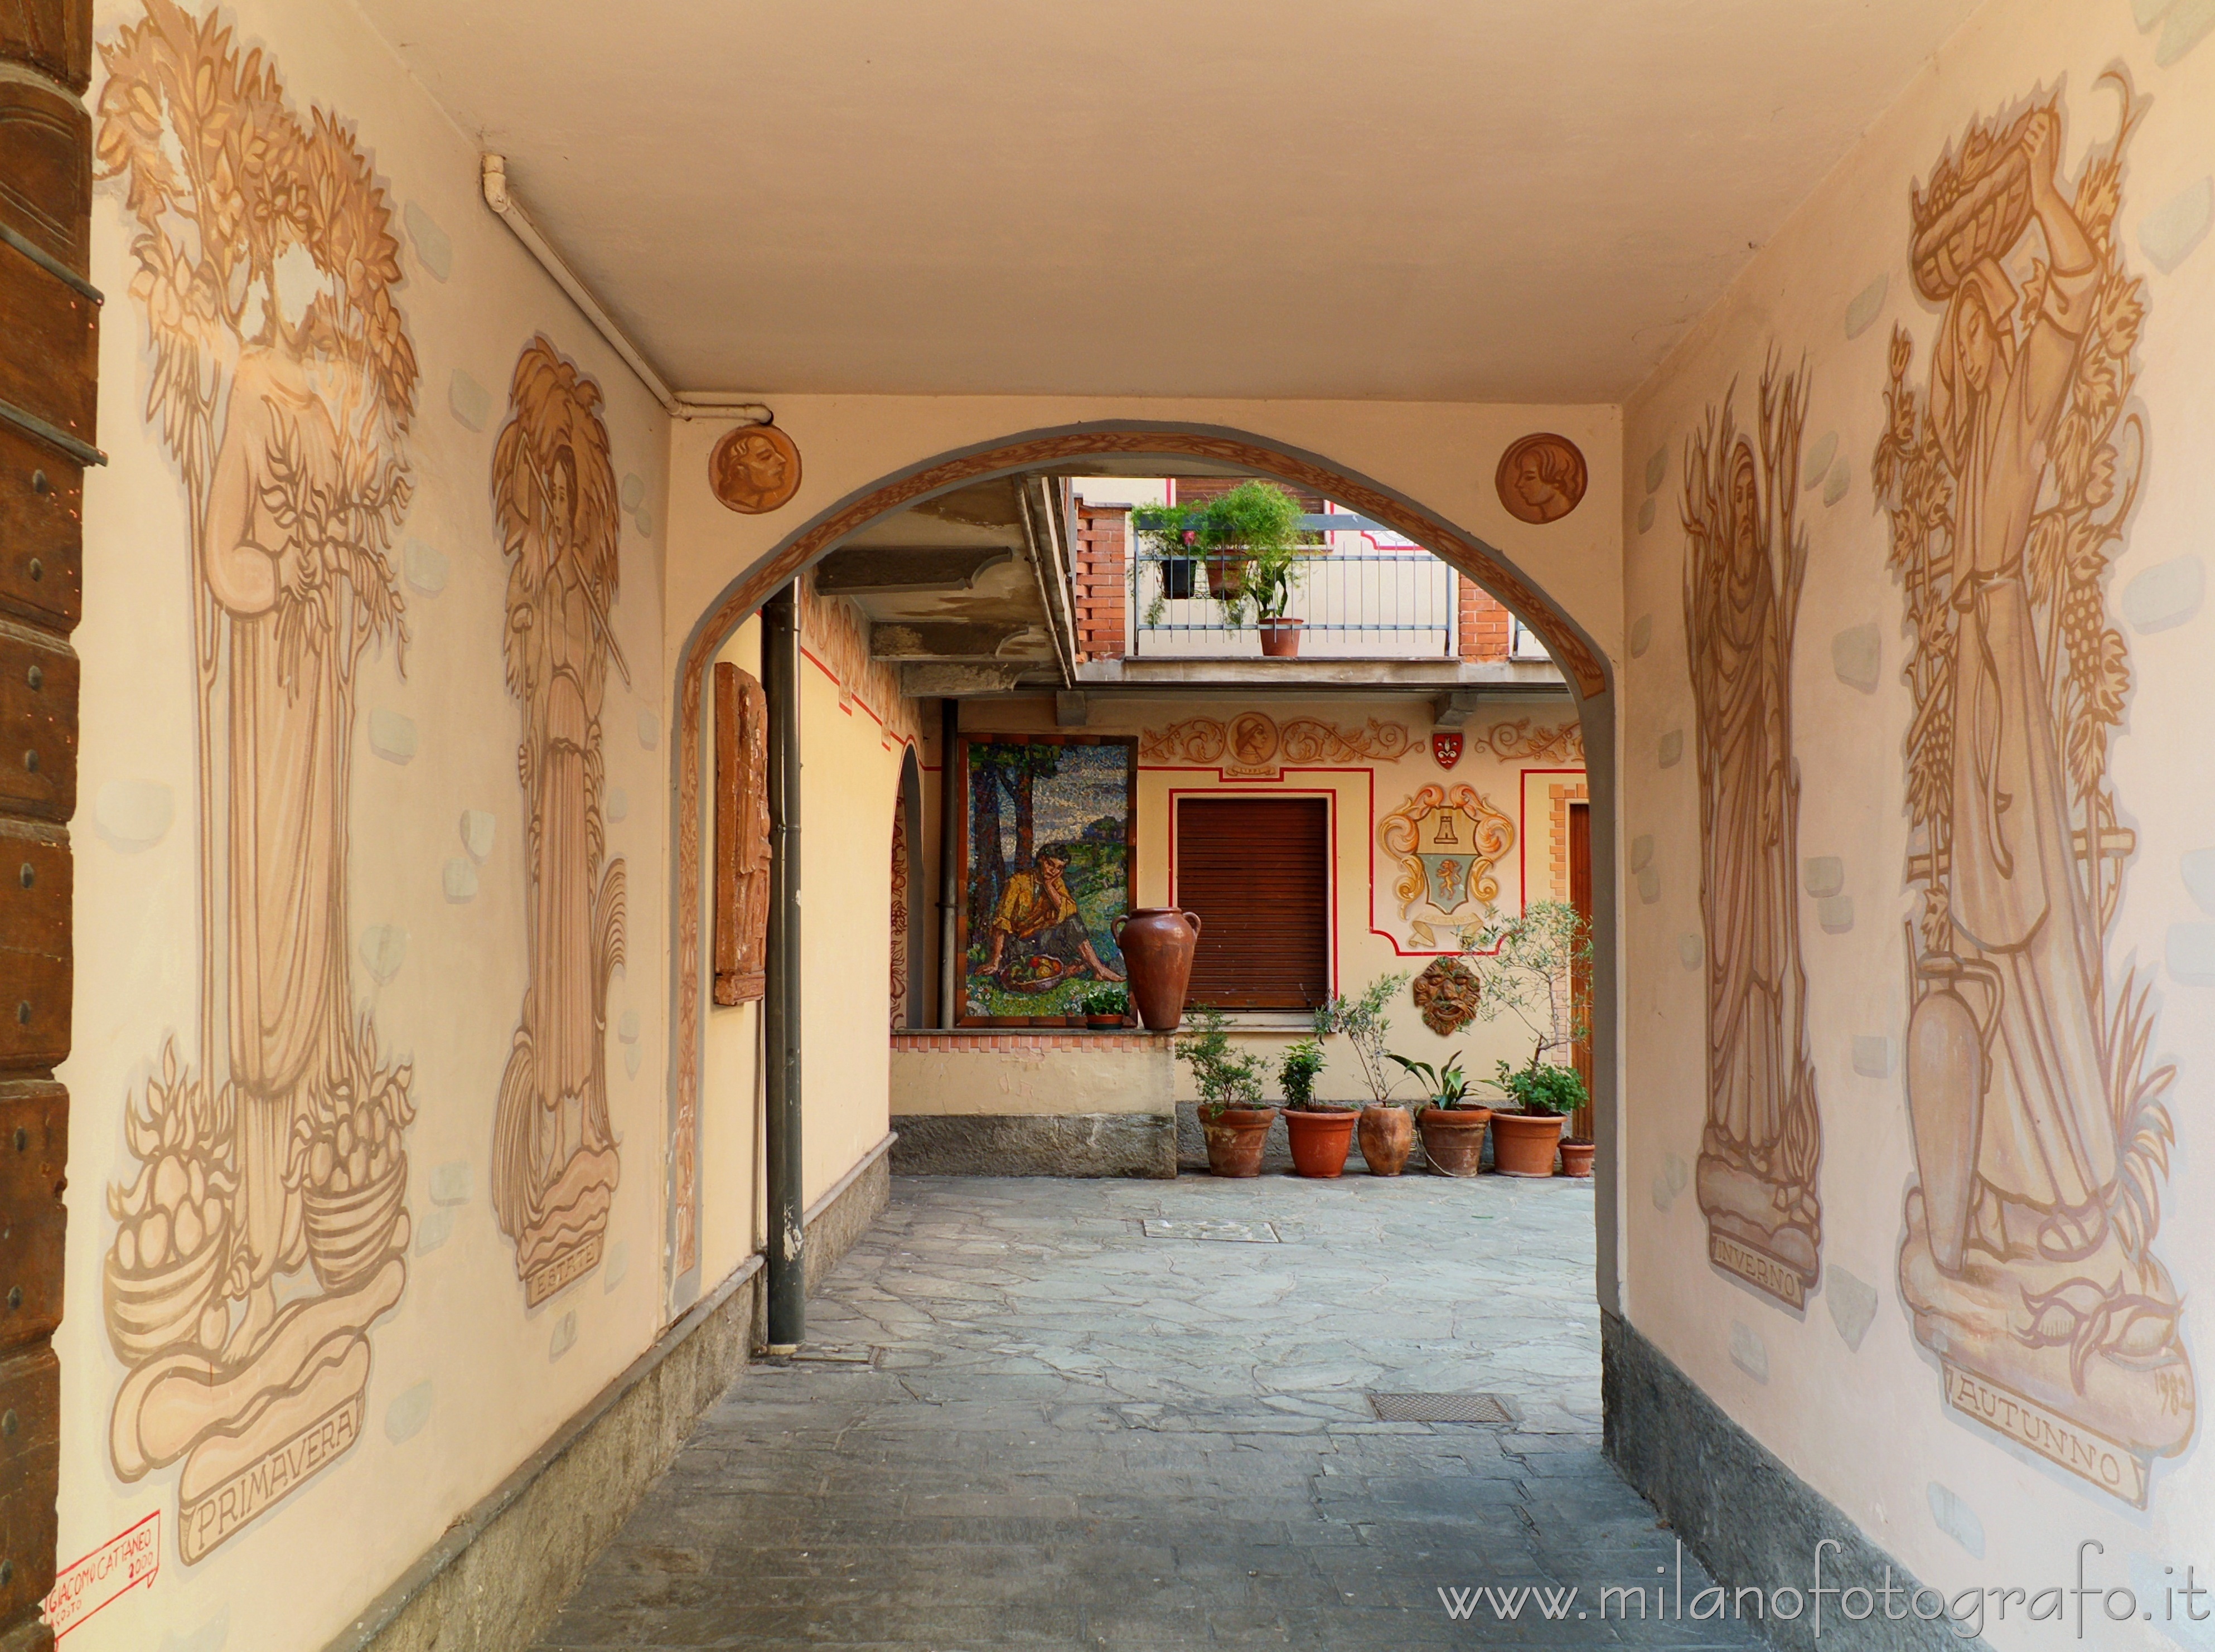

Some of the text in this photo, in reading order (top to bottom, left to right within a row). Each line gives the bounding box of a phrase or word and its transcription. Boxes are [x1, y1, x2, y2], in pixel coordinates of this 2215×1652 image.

[537, 1242, 595, 1296] ESTATE
[1718, 1240, 1795, 1297] INVERNO
[1956, 1374, 2120, 1485] AUTUNNO
[197, 1408, 355, 1551] PRIMAVERA
